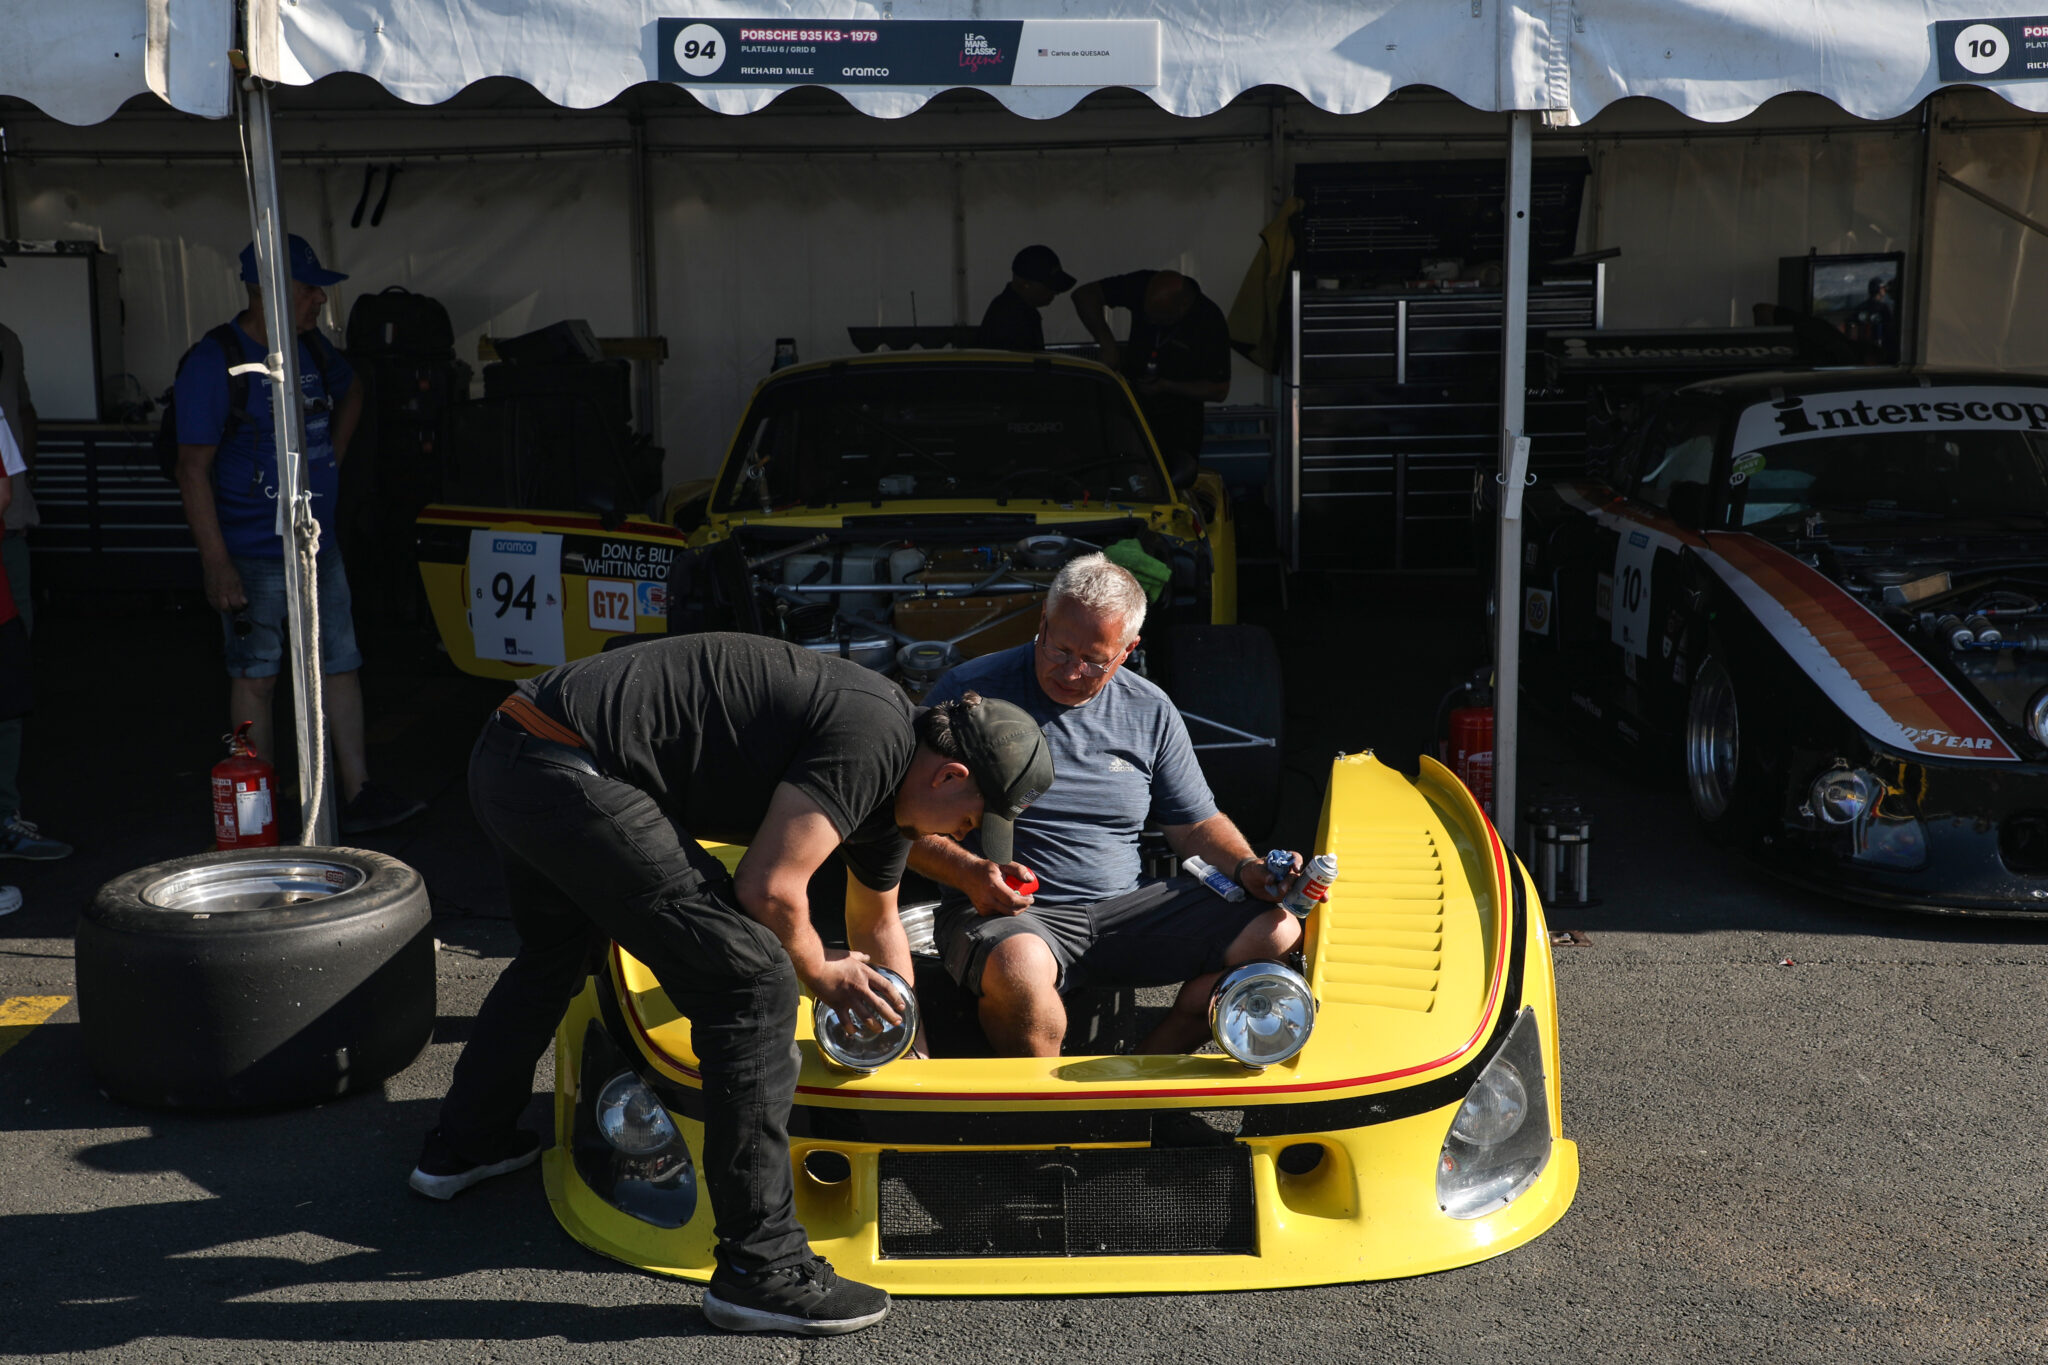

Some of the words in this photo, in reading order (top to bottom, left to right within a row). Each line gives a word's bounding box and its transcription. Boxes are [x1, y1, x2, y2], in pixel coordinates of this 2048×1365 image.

[740, 30, 798, 41] PORSCHE
[799, 30, 822, 41] 935
[824, 31, 841, 41] K3
[850, 31, 878, 42] 1979
[964, 33, 975, 41] LE
[684, 40, 716, 60] 94
[741, 45, 778, 53] PLATEAU
[964, 40, 988, 48] MANS
[1968, 39, 1997, 58] 10
[964, 47, 997, 56] CLASSIC
[740, 67, 783, 75] RICHARD
[785, 67, 815, 75] MILLE
[842, 67, 889, 77] aramco
[1562, 338, 1794, 359] interscope
[495, 541, 533, 553] aramco
[601, 543, 633, 560] DON
[635, 546, 646, 561] &
[476, 587, 483, 599] 6
[1622, 565, 1642, 613] 10
[492, 571, 536, 621] 94
[593, 590, 630, 621] GT2
